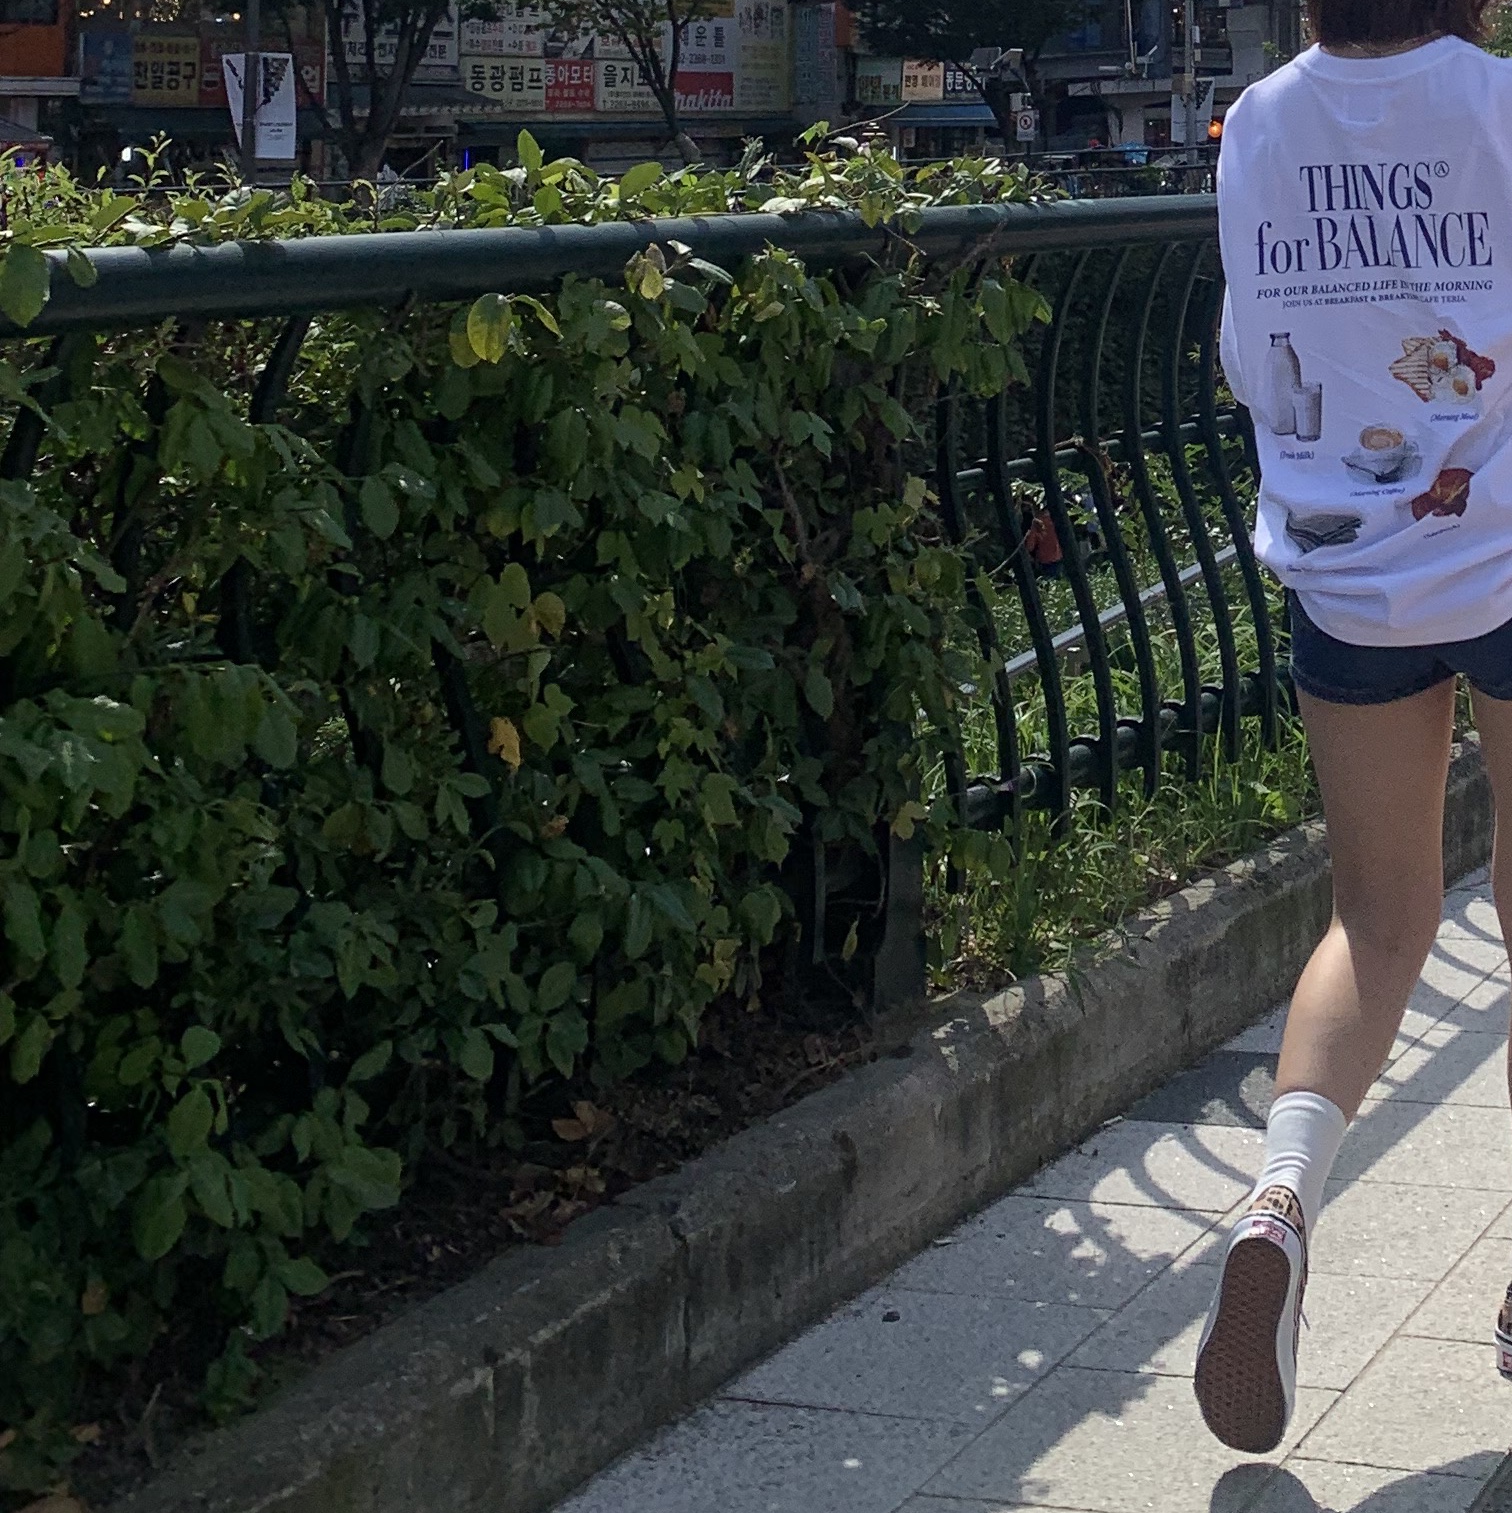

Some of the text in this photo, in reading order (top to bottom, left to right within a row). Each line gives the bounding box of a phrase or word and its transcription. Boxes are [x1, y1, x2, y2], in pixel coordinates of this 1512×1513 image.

[470, 64, 544, 92] 동광펌프
[545, 63, 594, 86] 동아모터
[1300, 162, 1434, 213] THINGS
[1255, 212, 1493, 276] for BALANCE
[1256, 288, 1280, 299] FOR
[1284, 285, 1309, 297] OUR
[1311, 281, 1370, 295] BALANCED
[1373, 279, 1398, 291] LIFE
[1409, 281, 1431, 293] THE
[1434, 279, 1494, 292] MORNING
[1282, 299, 1301, 309] JOIN
[1303, 298, 1313, 306] US
[1314, 297, 1323, 305] AT
[1324, 294, 1369, 305] BREAKFAST
